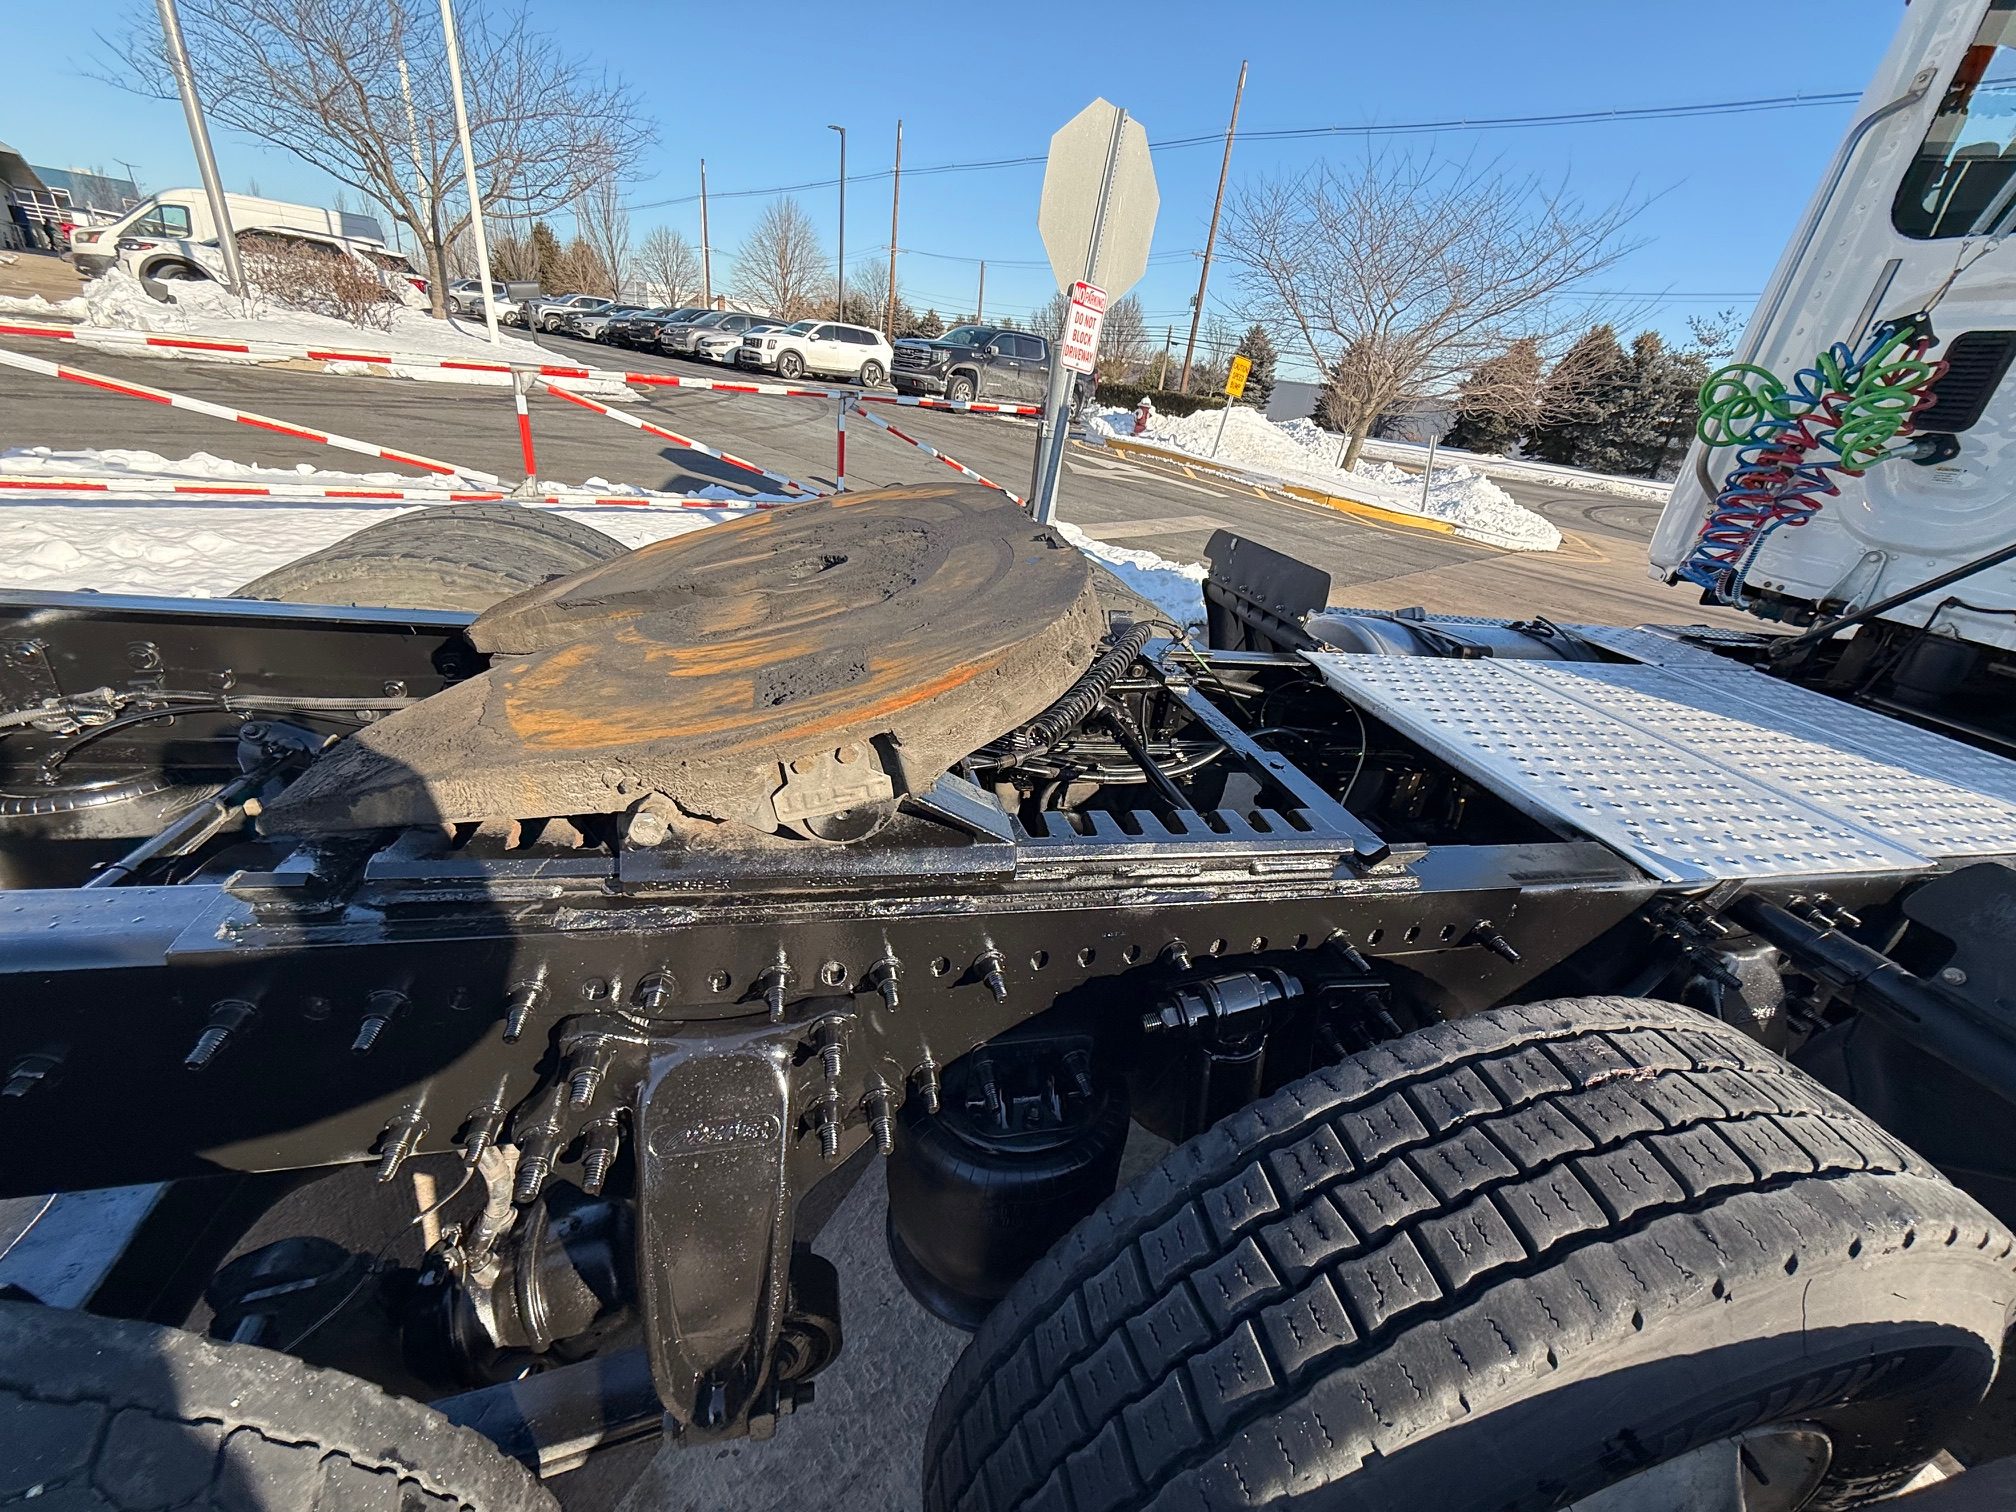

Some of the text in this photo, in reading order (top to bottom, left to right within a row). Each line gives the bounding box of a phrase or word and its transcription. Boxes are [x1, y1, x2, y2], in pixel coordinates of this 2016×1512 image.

[1073, 287, 1105, 309] NO PARKING
[1074, 311, 1097, 330] DO NOT
[1072, 330, 1093, 346] BLOCK
[1064, 345, 1094, 363] DRIVEWAY
